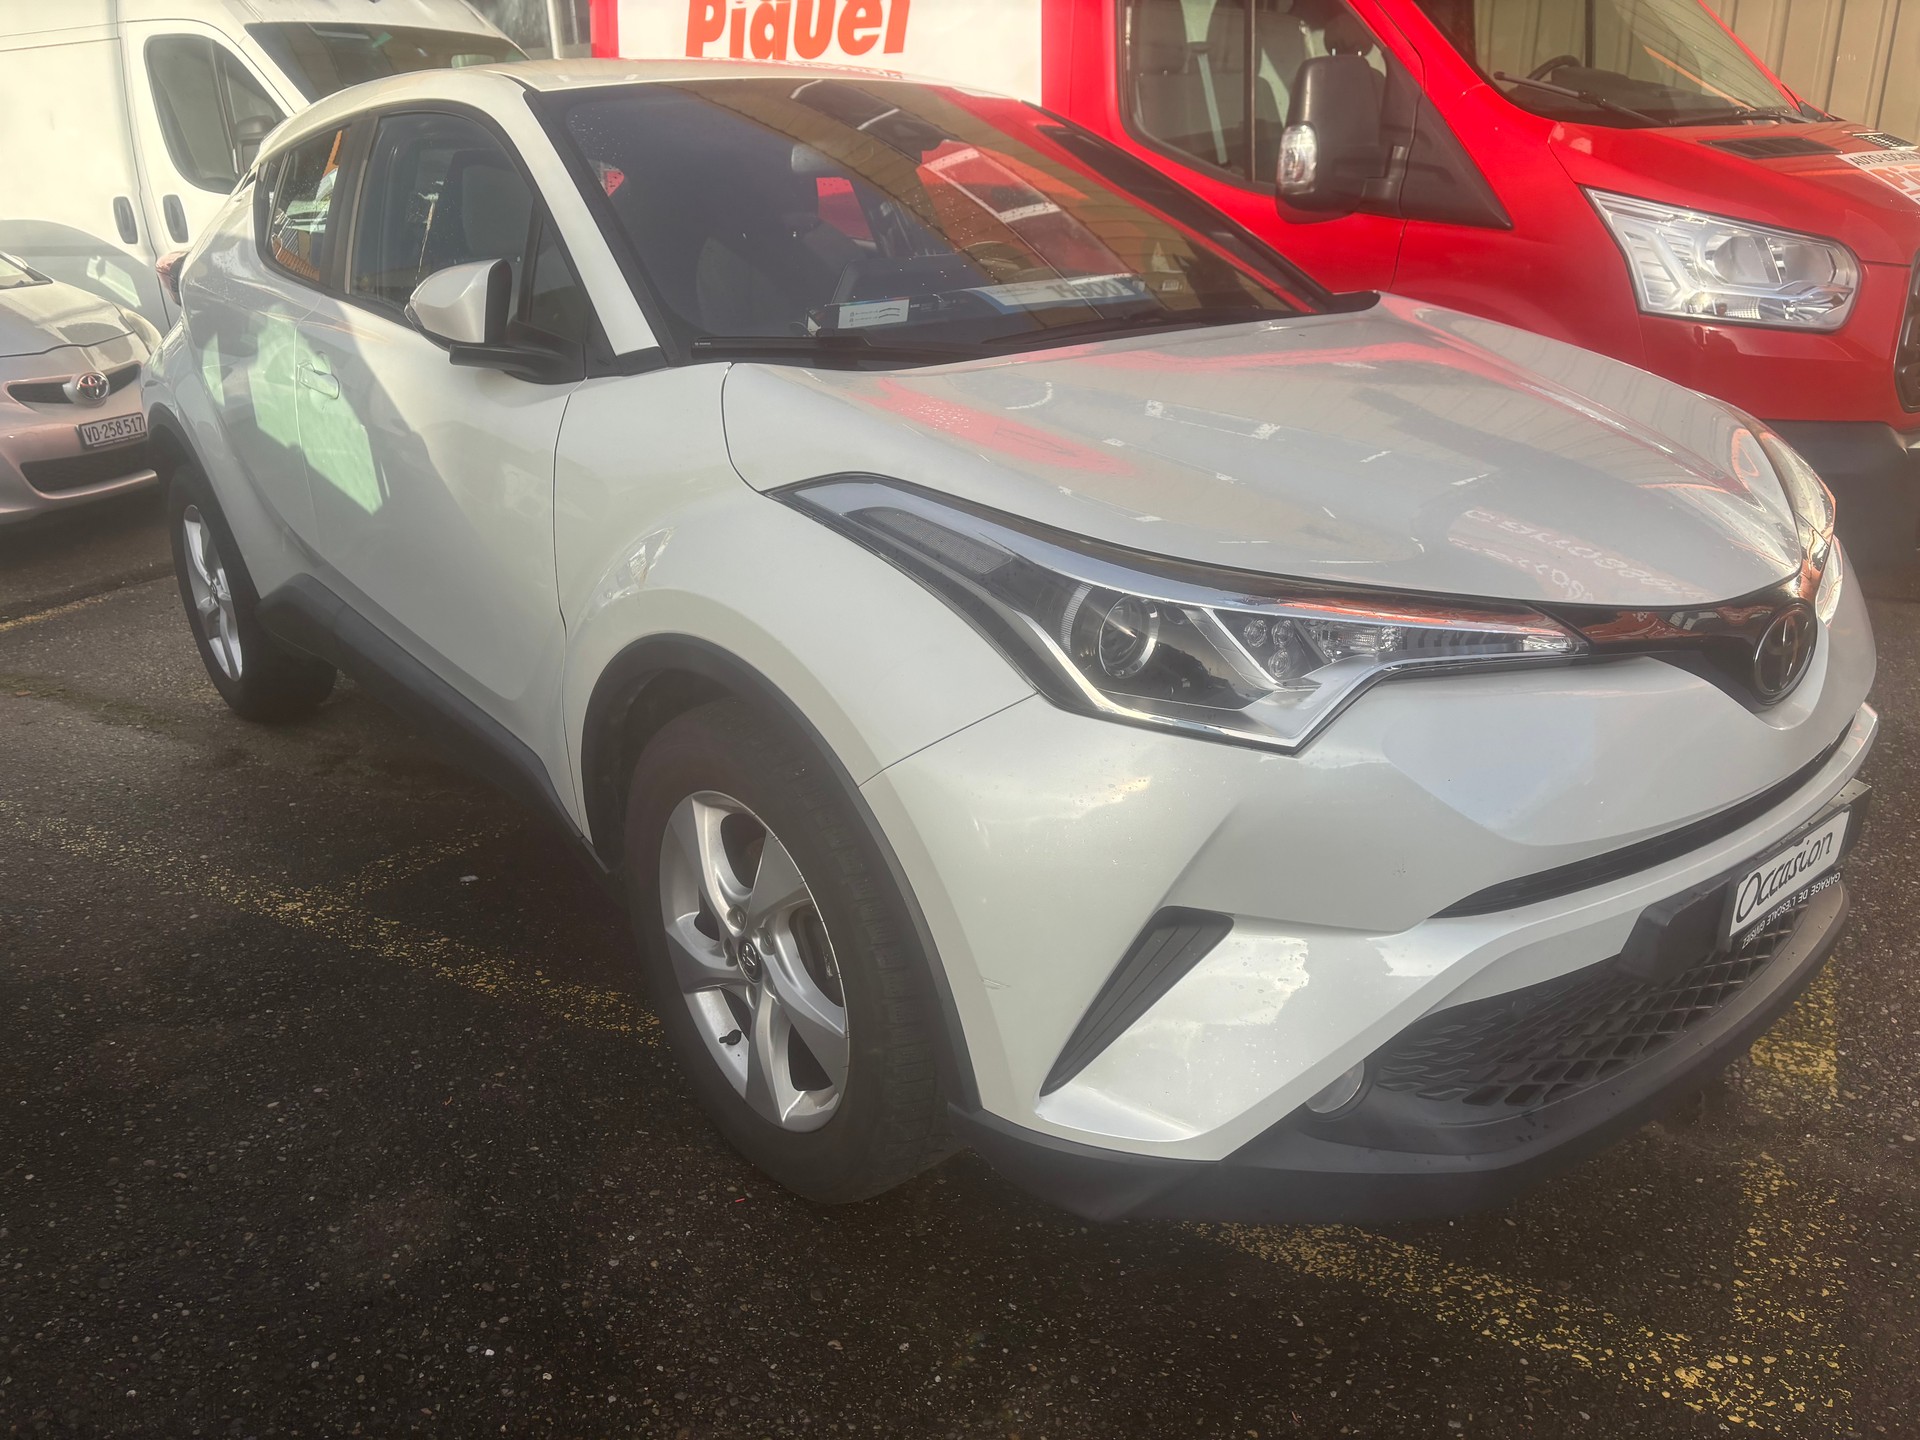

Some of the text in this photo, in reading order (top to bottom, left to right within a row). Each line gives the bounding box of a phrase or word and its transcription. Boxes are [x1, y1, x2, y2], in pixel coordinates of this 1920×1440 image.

[1735, 831, 1833, 923] Occasion
[1810, 872, 1841, 896] GARAGE
[1797, 888, 1809, 903] DE
